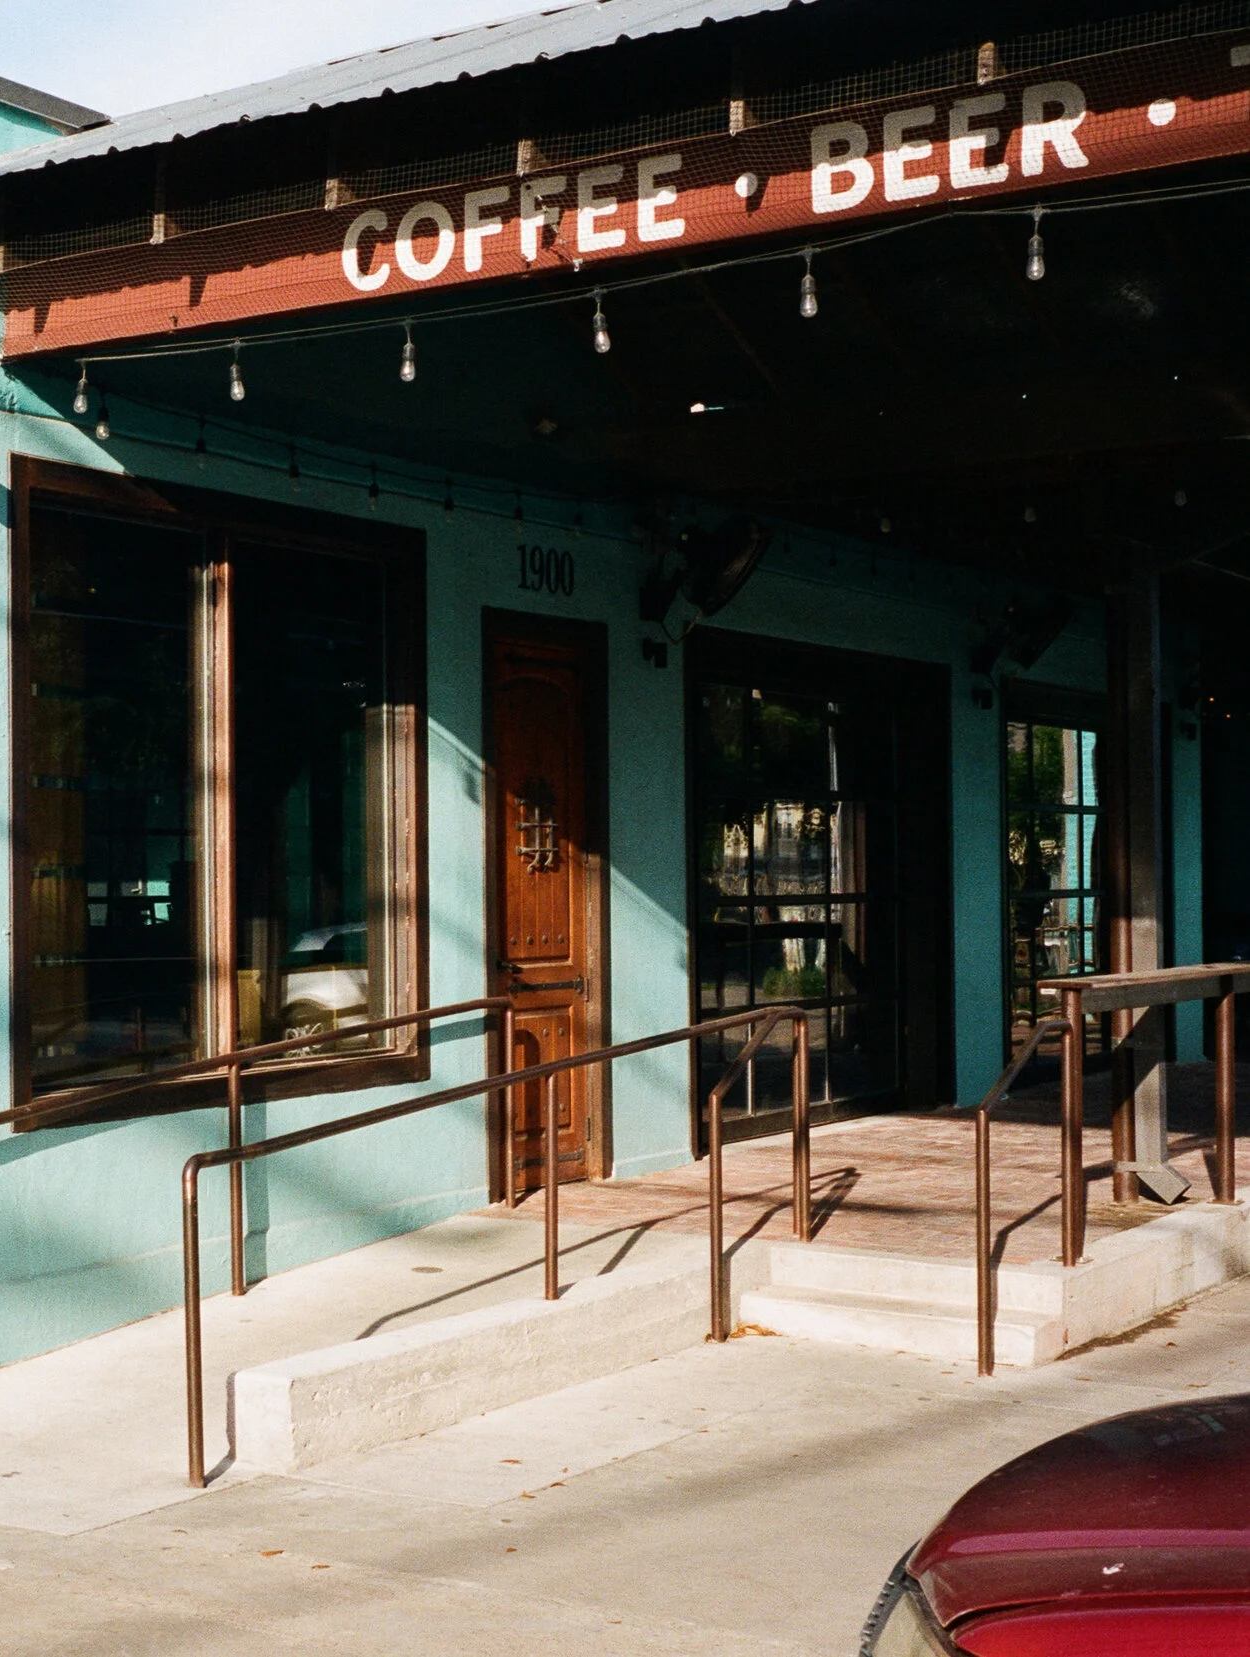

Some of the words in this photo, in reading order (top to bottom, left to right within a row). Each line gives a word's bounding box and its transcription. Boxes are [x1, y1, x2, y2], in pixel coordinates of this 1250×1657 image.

[341, 153, 686, 292] COFFEE
[809, 79, 1090, 215] BEER
[516, 544, 575, 597] 1900
